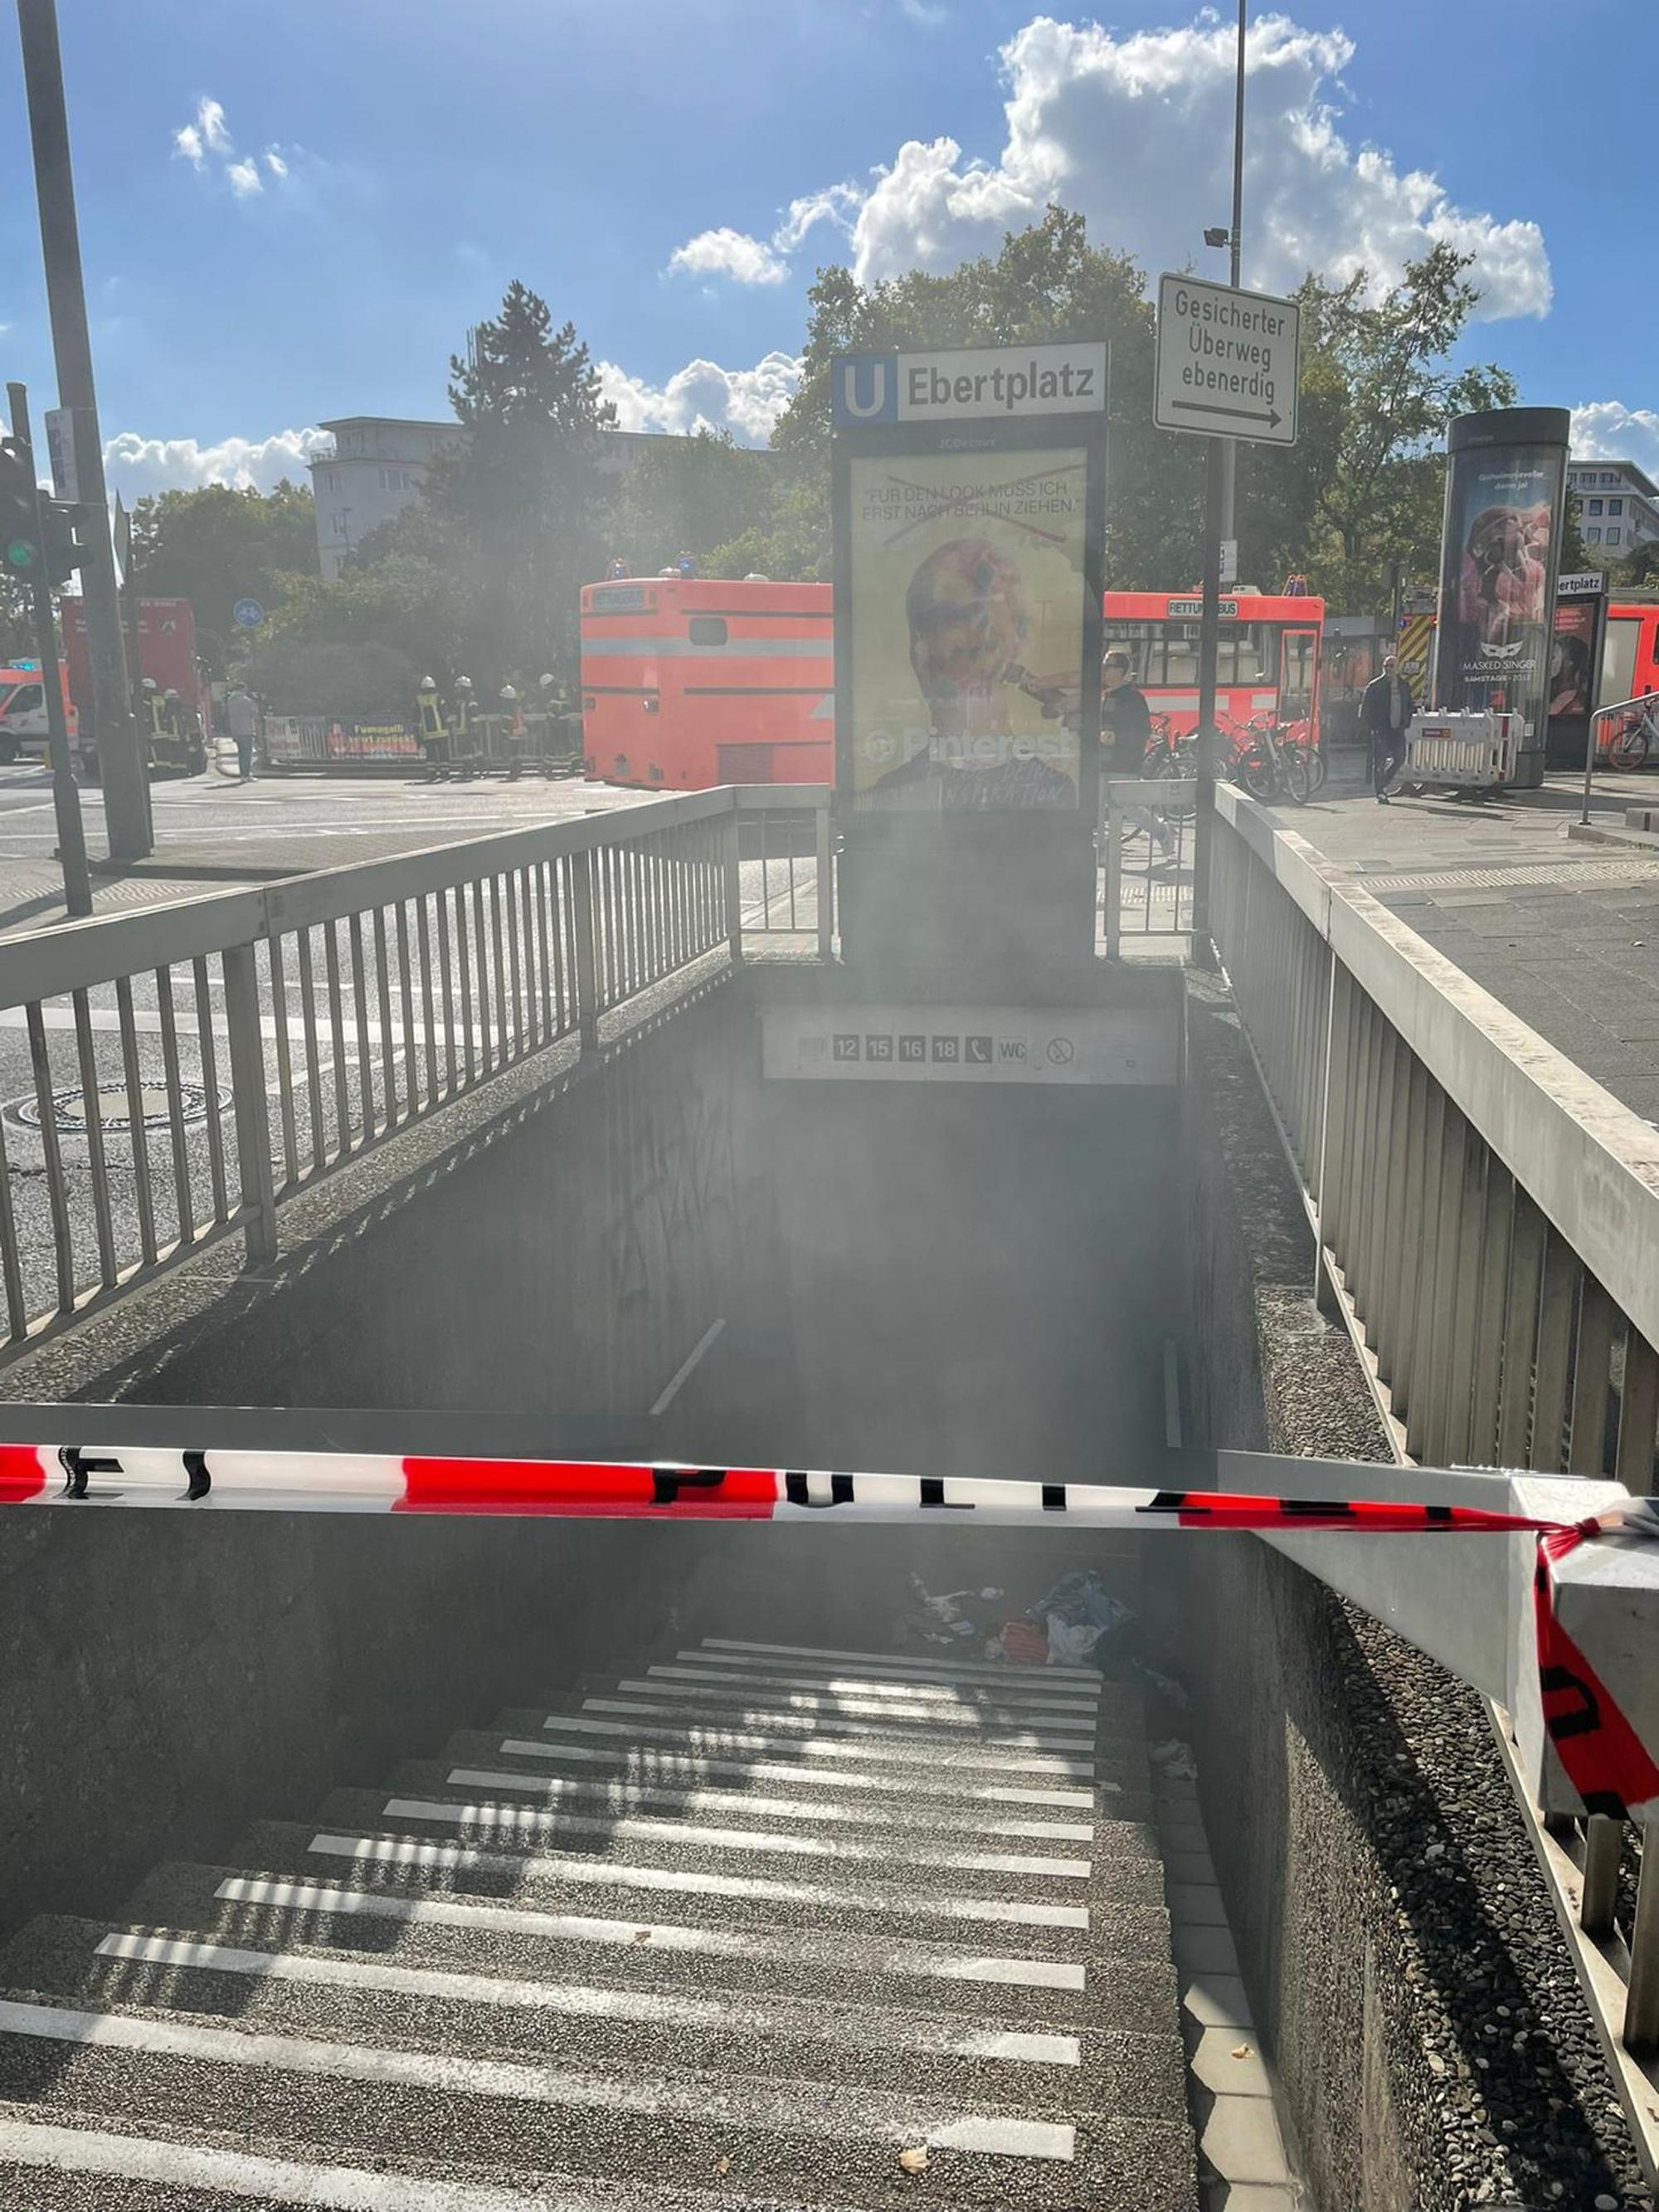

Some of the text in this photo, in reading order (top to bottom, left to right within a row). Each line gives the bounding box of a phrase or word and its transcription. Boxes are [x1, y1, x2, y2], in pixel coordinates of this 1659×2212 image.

[1175, 290, 1285, 337] Gesicherter
[1189, 321, 1272, 373] Überweg
[844, 360, 1094, 418] U Ebertplatz
[1182, 361, 1275, 405] ebenerdig
[1040, 480, 1068, 496] ICH
[1559, 577, 1600, 593] ertplatz
[902, 726, 1080, 762] Pinterest
[836, 1040, 1026, 1060] 12 15 16 18 WC
